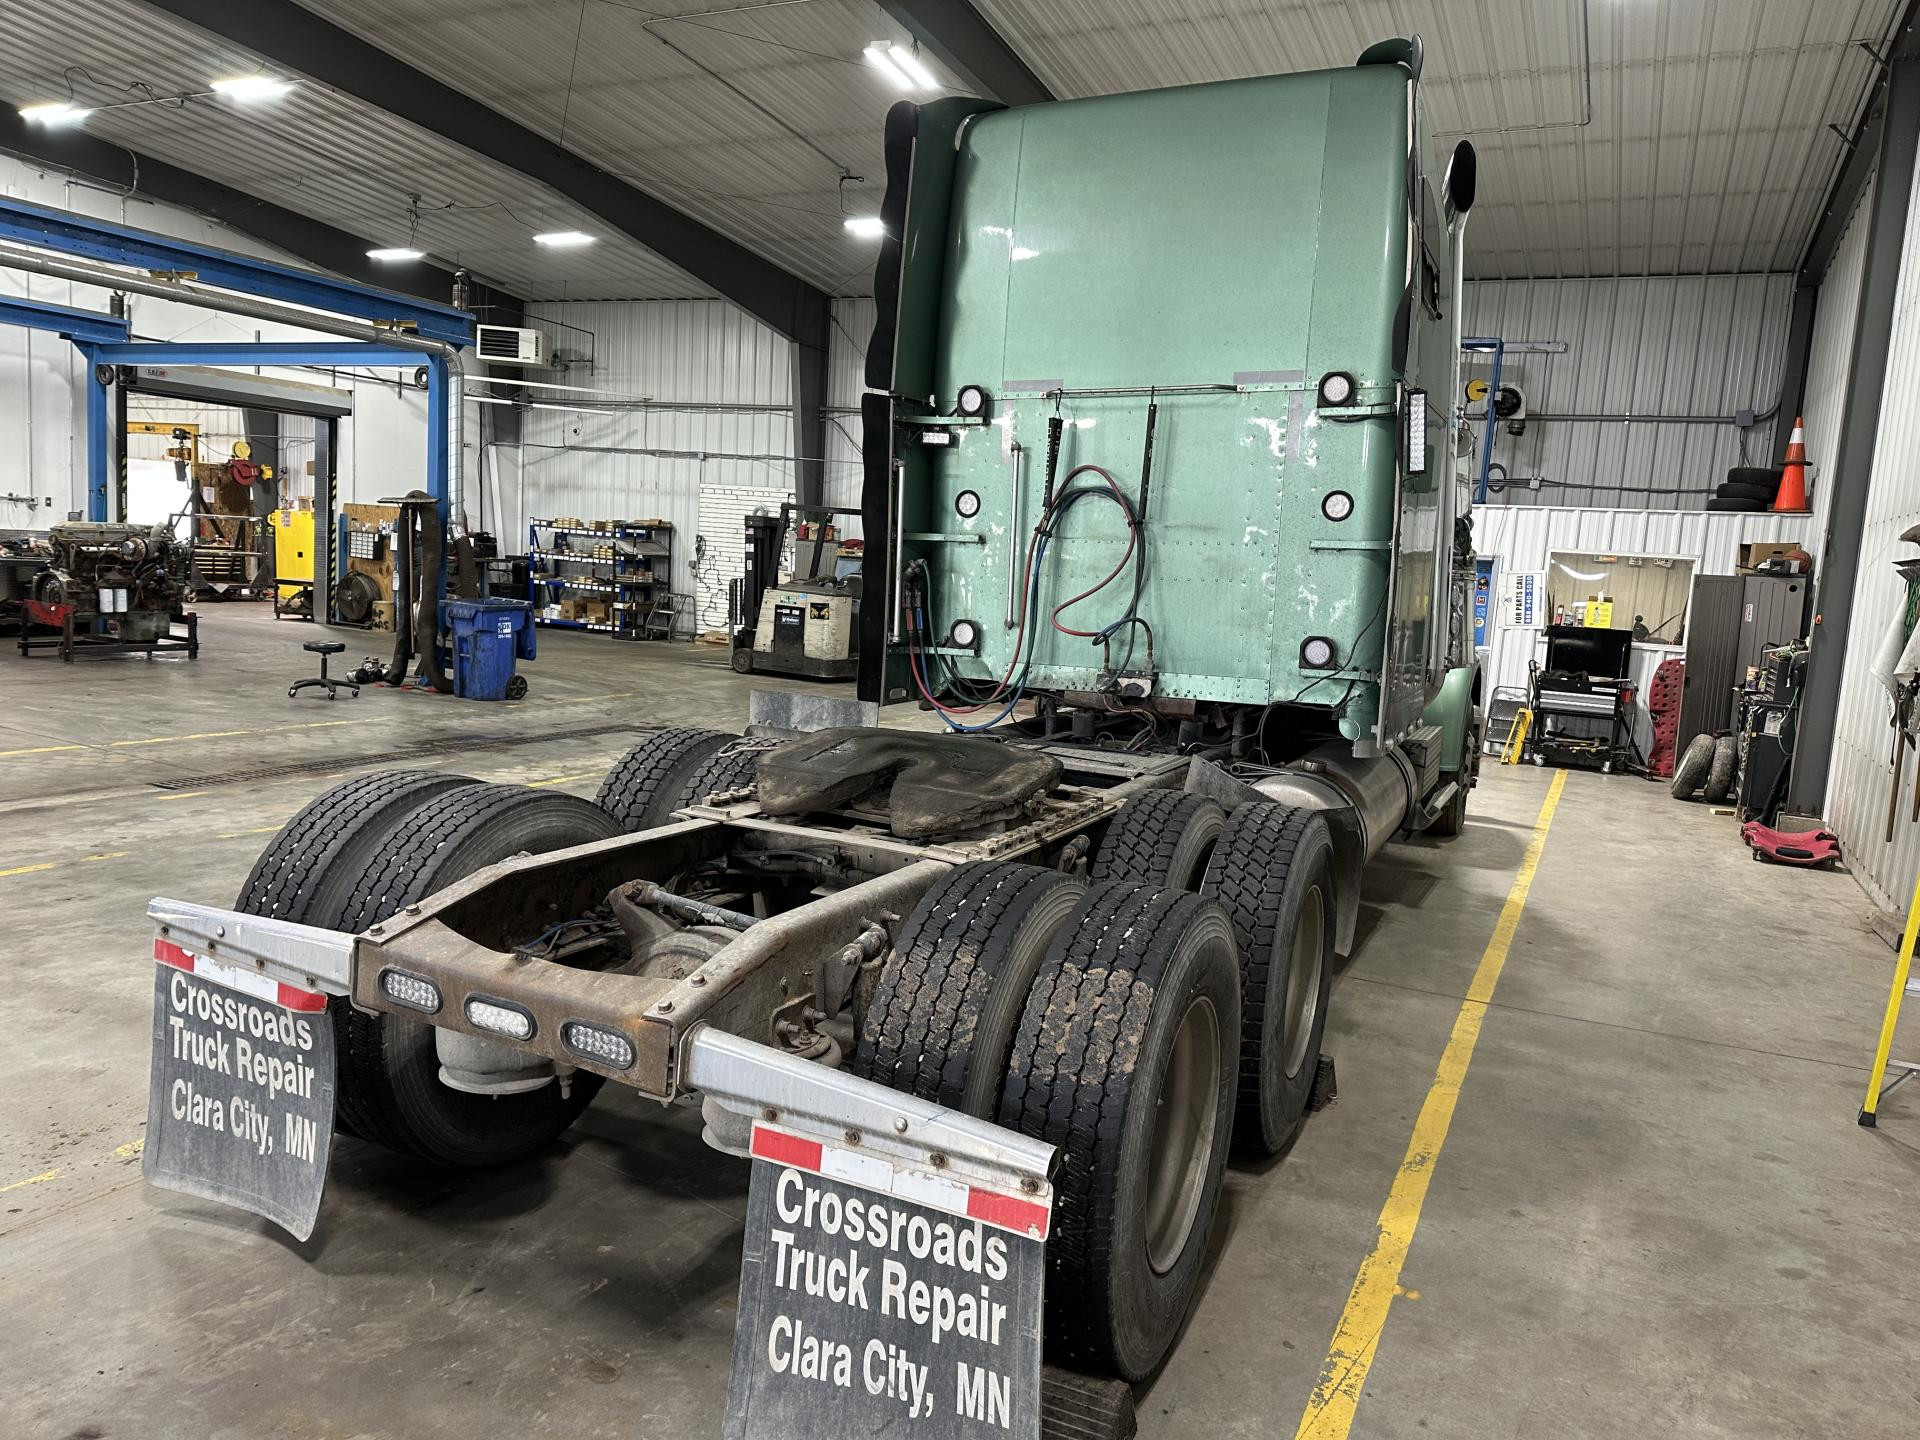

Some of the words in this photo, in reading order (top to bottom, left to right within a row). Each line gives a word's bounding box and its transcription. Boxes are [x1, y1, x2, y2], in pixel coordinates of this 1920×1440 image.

[169, 1015, 230, 1075] Truck
[236, 1038, 315, 1099] Repair
[170, 971, 313, 1051] Crossroads
[171, 1078, 224, 1132] Clara
[229, 1096, 273, 1155] City,
[285, 1112, 317, 1164] MN
[776, 1168, 1009, 1281] Crossroads
[771, 1228, 870, 1310] Truck
[881, 1257, 1007, 1345] Repair
[768, 1315, 851, 1387] Clara
[863, 1338, 934, 1419] City,
[956, 1361, 1011, 1429] MN
